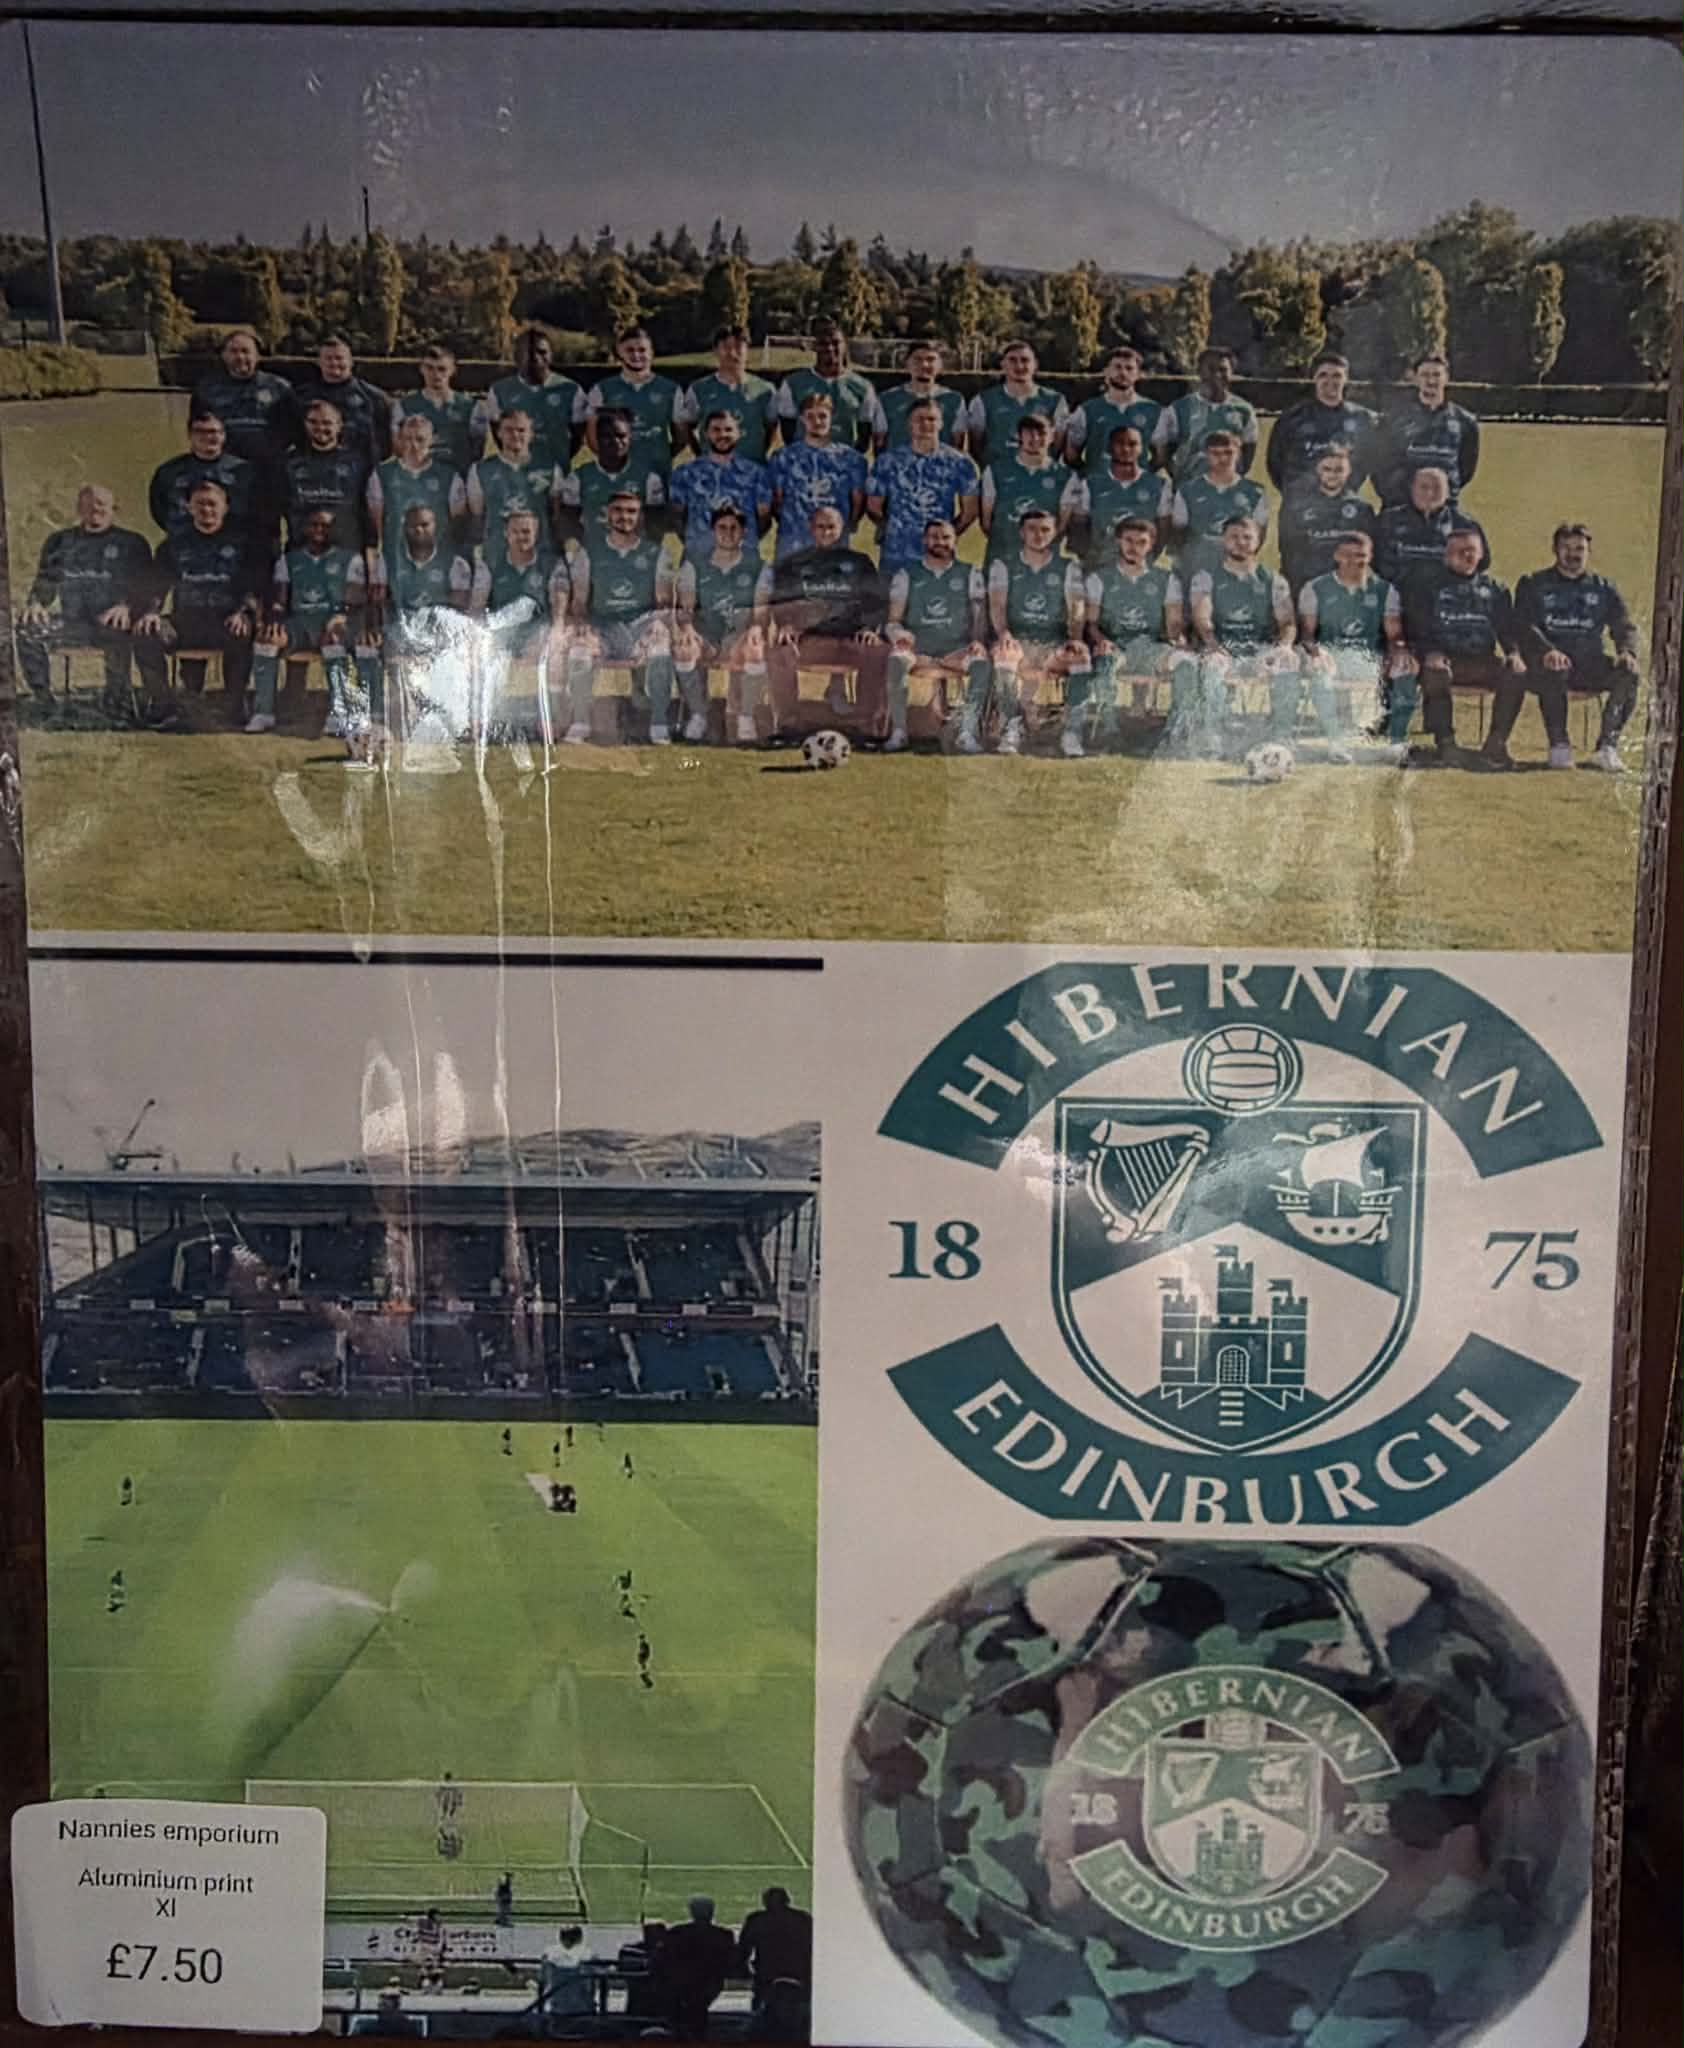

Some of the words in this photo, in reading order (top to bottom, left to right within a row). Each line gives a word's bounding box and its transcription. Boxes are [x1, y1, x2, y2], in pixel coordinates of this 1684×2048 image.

[938, 963, 1547, 1137] HIBERNIAN
[888, 1219, 982, 1280] 18
[1485, 1228, 1581, 1291] 75
[952, 1378, 1512, 1524] EDINBURGH
[1096, 1677, 1371, 1764] HIBERNIAN
[58, 1819, 156, 1841] Nannies
[163, 1824, 279, 1846] emporium
[78, 1867, 197, 1891] Aluminium
[204, 1873, 254, 1896] print
[1103, 1868, 1354, 1938] EDINBURGH
[106, 1942, 223, 1984] £7.50
